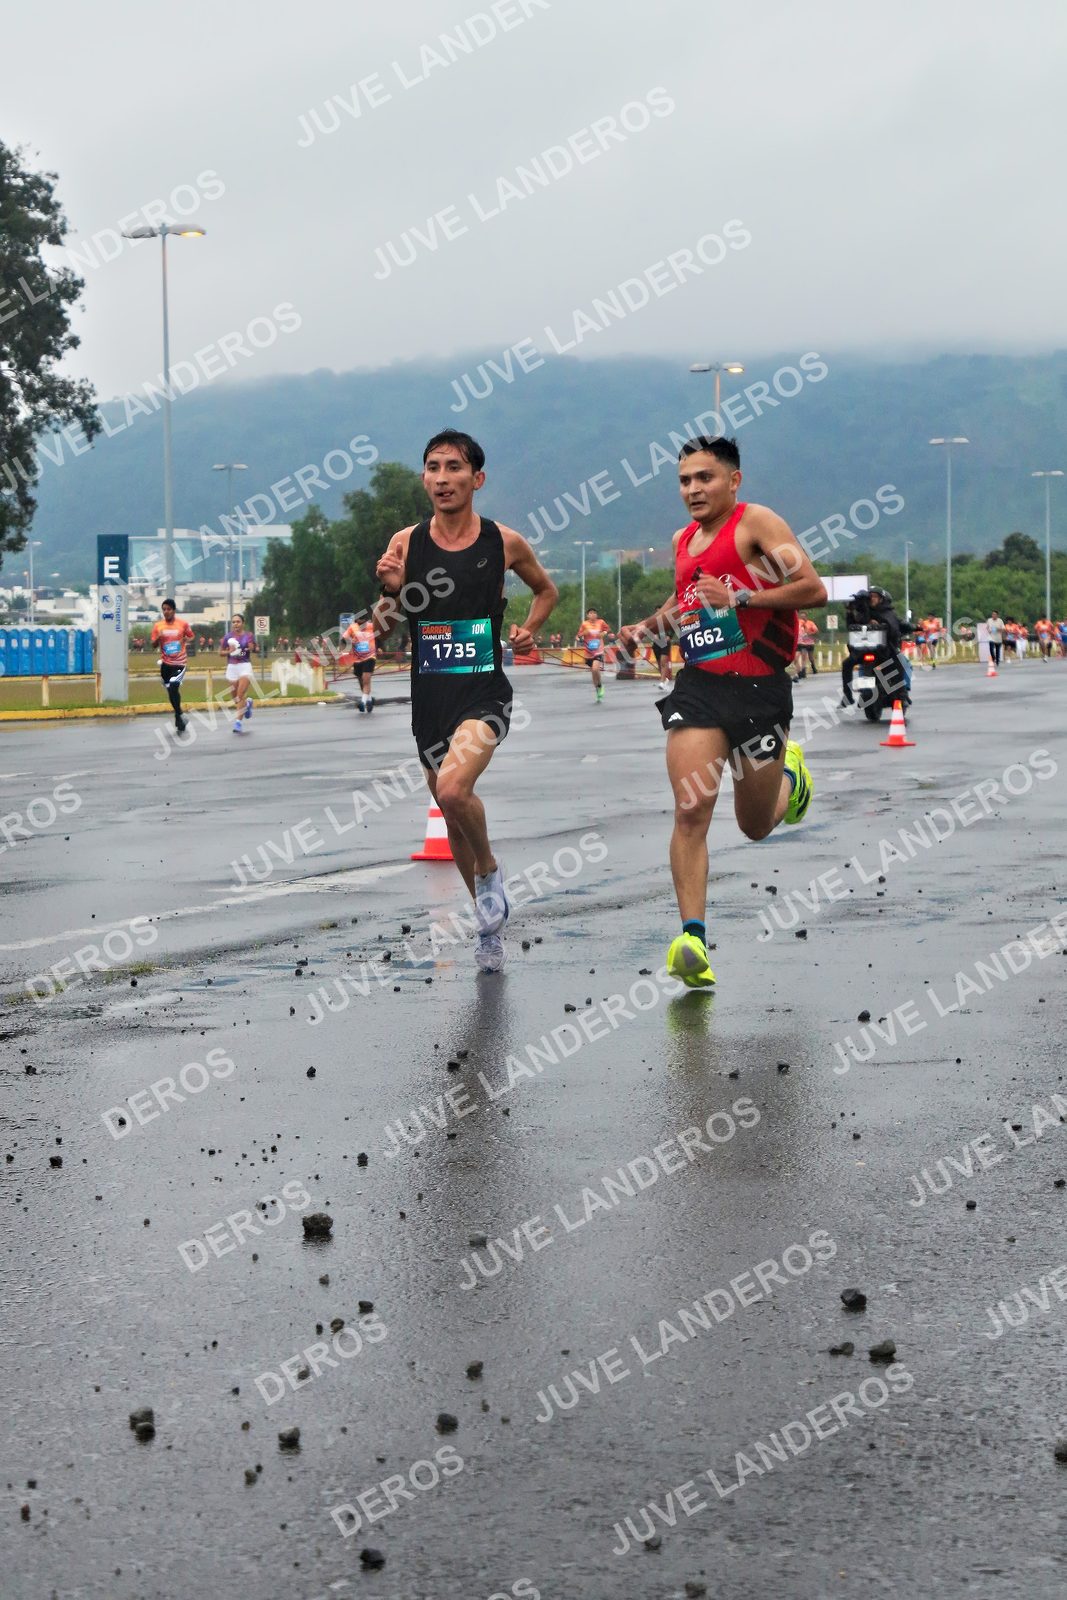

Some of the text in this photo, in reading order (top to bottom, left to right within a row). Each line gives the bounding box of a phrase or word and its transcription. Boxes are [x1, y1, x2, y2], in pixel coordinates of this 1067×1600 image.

[104, 556, 120, 578] E
[471, 623, 486, 634] 10K
[687, 627, 724, 649] 1662
[432, 642, 476, 659] 1735
